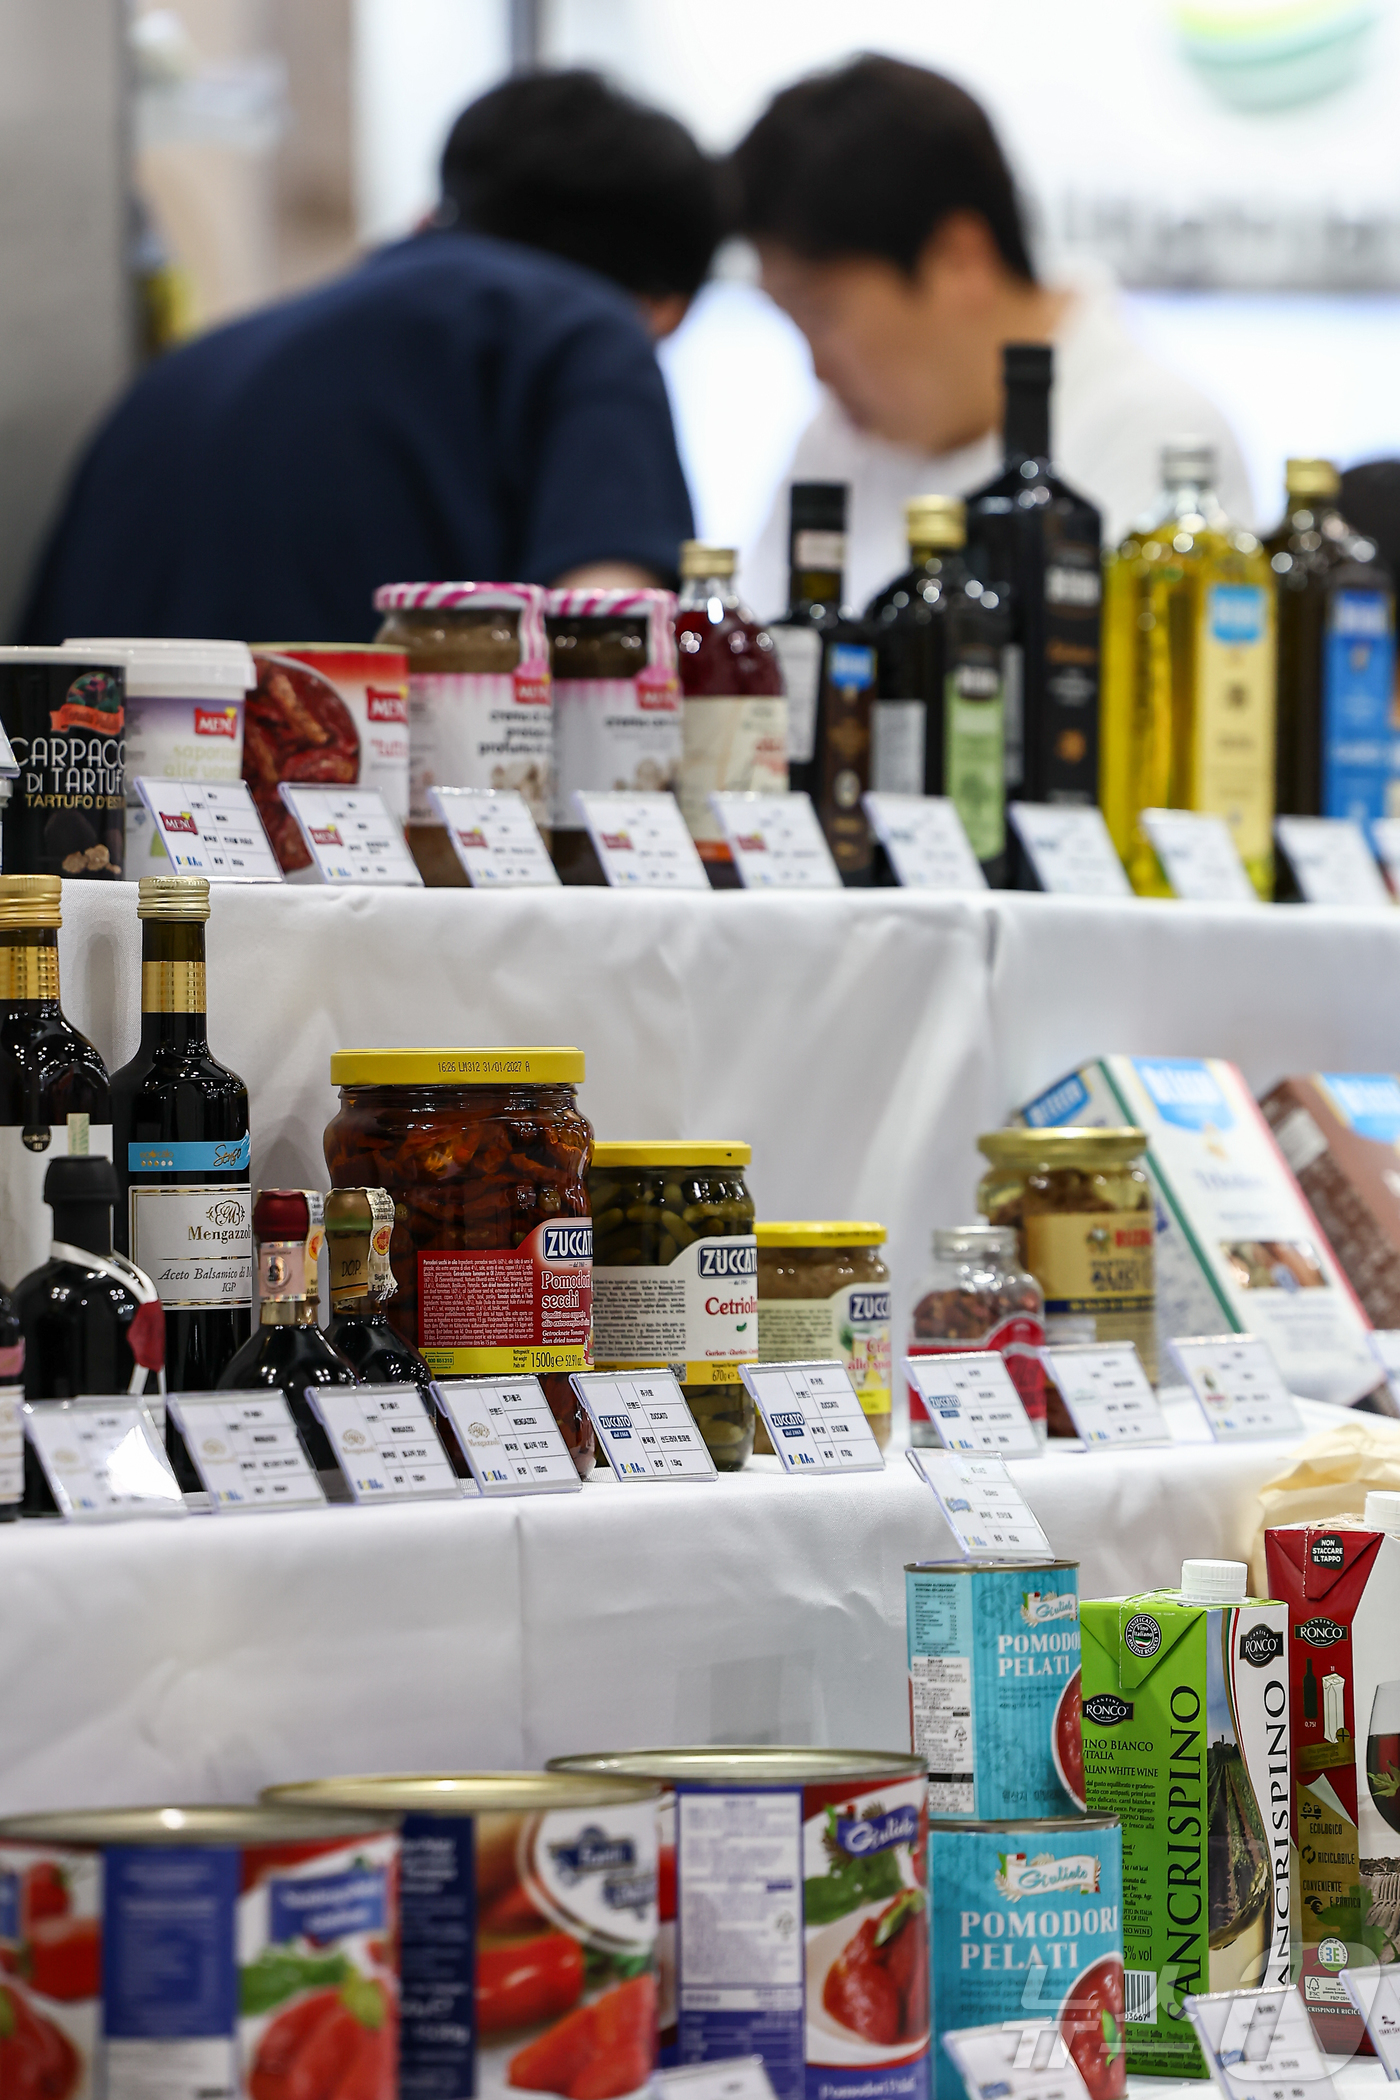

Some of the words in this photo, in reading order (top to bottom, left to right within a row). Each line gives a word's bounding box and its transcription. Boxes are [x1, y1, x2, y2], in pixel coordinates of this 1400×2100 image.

[27, 773, 43, 793] DI
[26, 794, 93, 809] TARTUFO
[483, 1061, 523, 1073] 31/01/2027
[158, 1268, 189, 1281] Aceto
[194, 1267, 238, 1281] Balsamico
[239, 1266, 246, 1278] di
[541, 1270, 590, 1290] Pomodori
[222, 1282, 237, 1293] IGP
[541, 1289, 580, 1309] secchi
[542, 1329, 570, 1337] Getrocknete
[531, 1352, 555, 1368] 1500g
[601, 1416, 631, 1429] ZUCCATO
[771, 1413, 804, 1427] ZUCCATO
[1321, 1539, 1336, 1547] NON
[1312, 1547, 1344, 1555] STACCARE
[1314, 1555, 1320, 1563] IL
[1320, 1555, 1342, 1563] TAPPO
[1306, 1618, 1335, 1627] CANTINE
[1300, 1626, 1343, 1639] RONCO
[1245, 1638, 1276, 1653] RONCO
[997, 1655, 1071, 1677] PELATI
[1092, 1697, 1120, 1706] CANTINE
[1086, 1704, 1127, 1717] RONCO
[1111, 1739, 1154, 1752] BIANCO
[1108, 1766, 1136, 1777] WHITE
[1137, 1767, 1159, 1778] WINE
[1309, 1822, 1343, 1835] ECOLOGICO
[1317, 1852, 1356, 1865] RICICLABILE
[1302, 1880, 1342, 1892] CONVENIENTE
[959, 1905, 1118, 1938] POMODORI
[1133, 1927, 1150, 1935] WINE
[959, 1942, 1078, 1970] PELATI
[1138, 1946, 1152, 1961] vol
[1325, 1946, 1340, 1962] 3E
